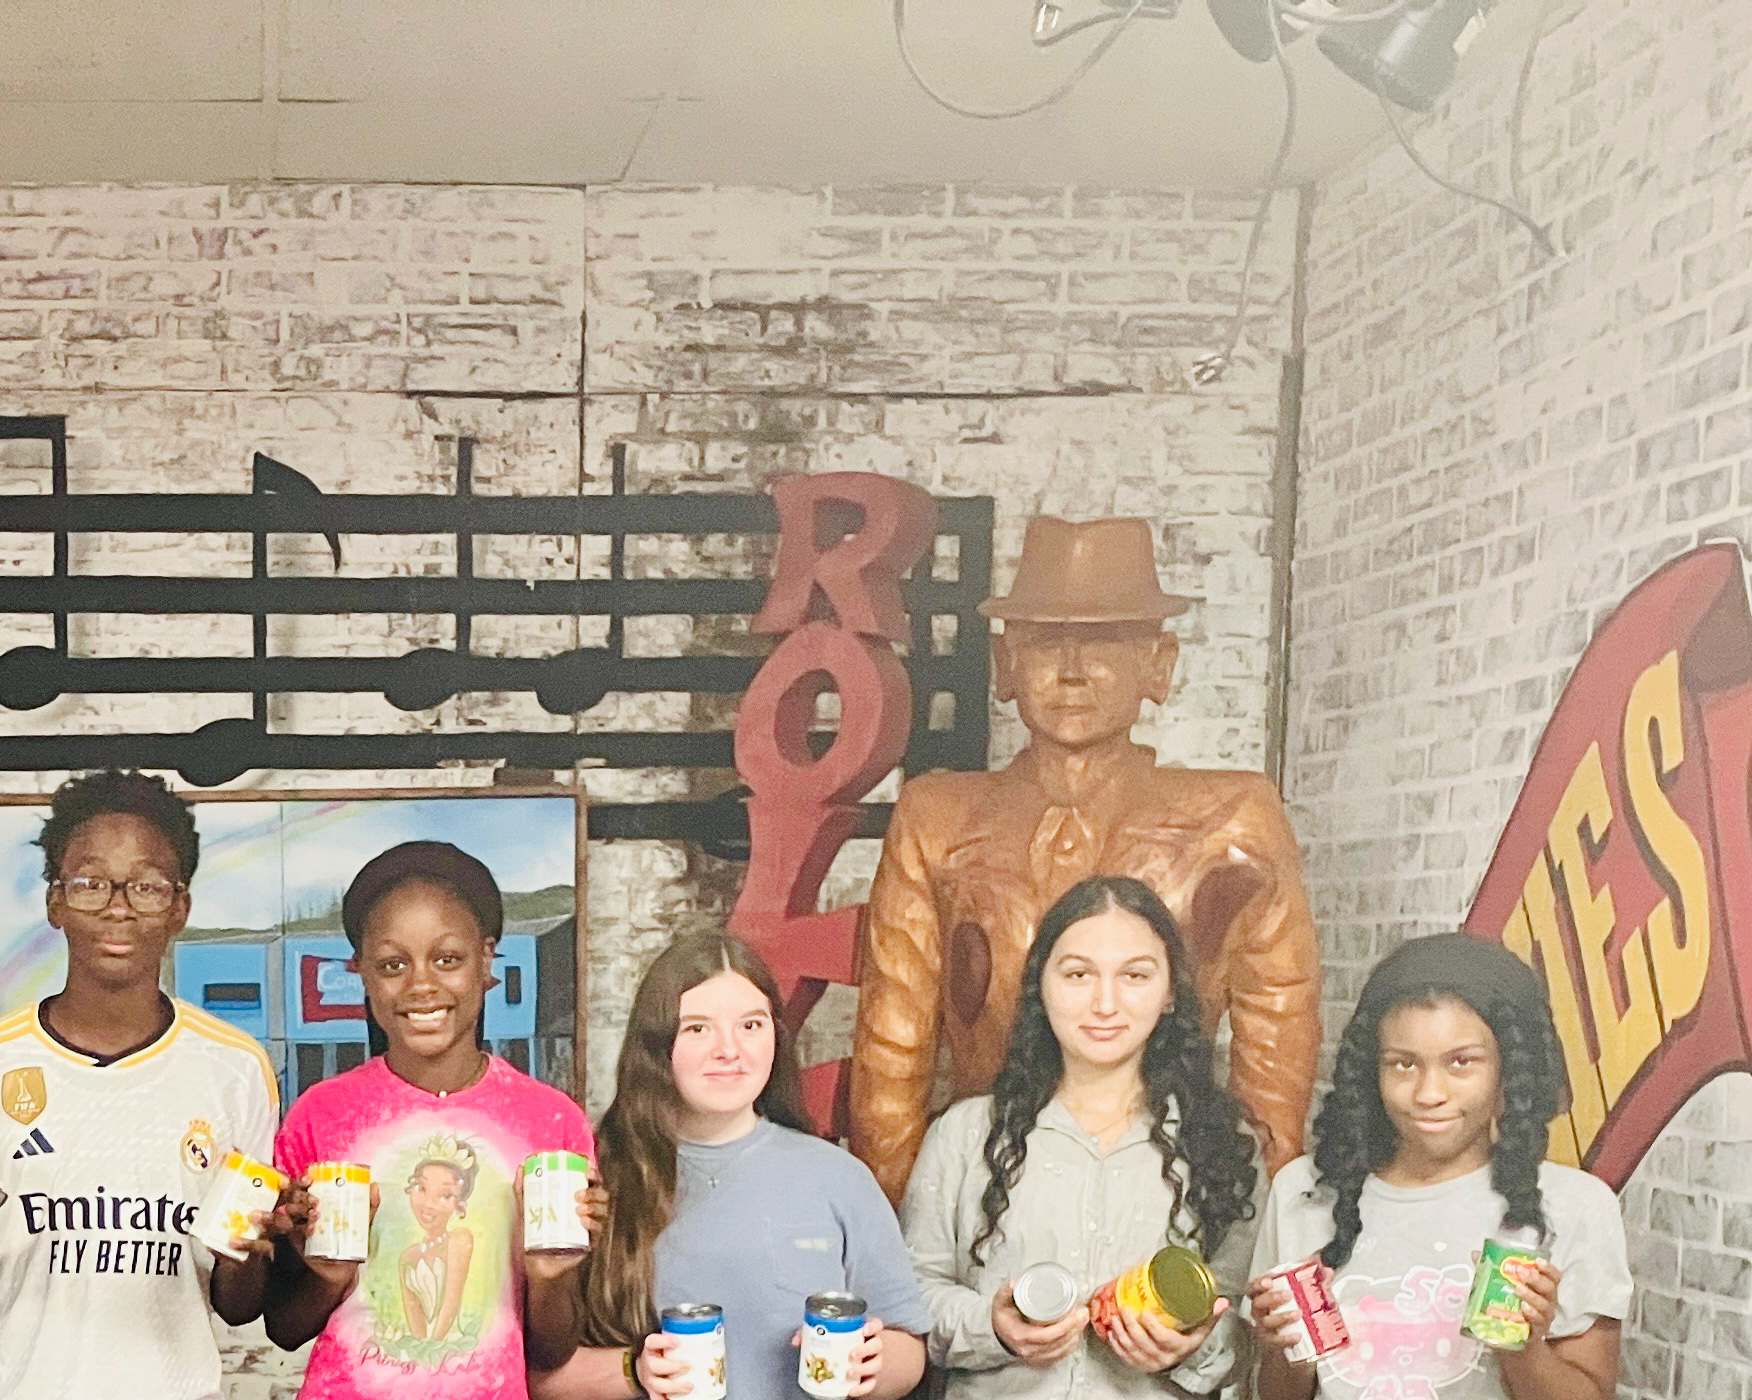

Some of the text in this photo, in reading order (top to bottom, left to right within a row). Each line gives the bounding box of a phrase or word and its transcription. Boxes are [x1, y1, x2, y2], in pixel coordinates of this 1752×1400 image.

[728, 470, 936, 1140] ROL
[48, 1239, 183, 1277] FLY BETTER
